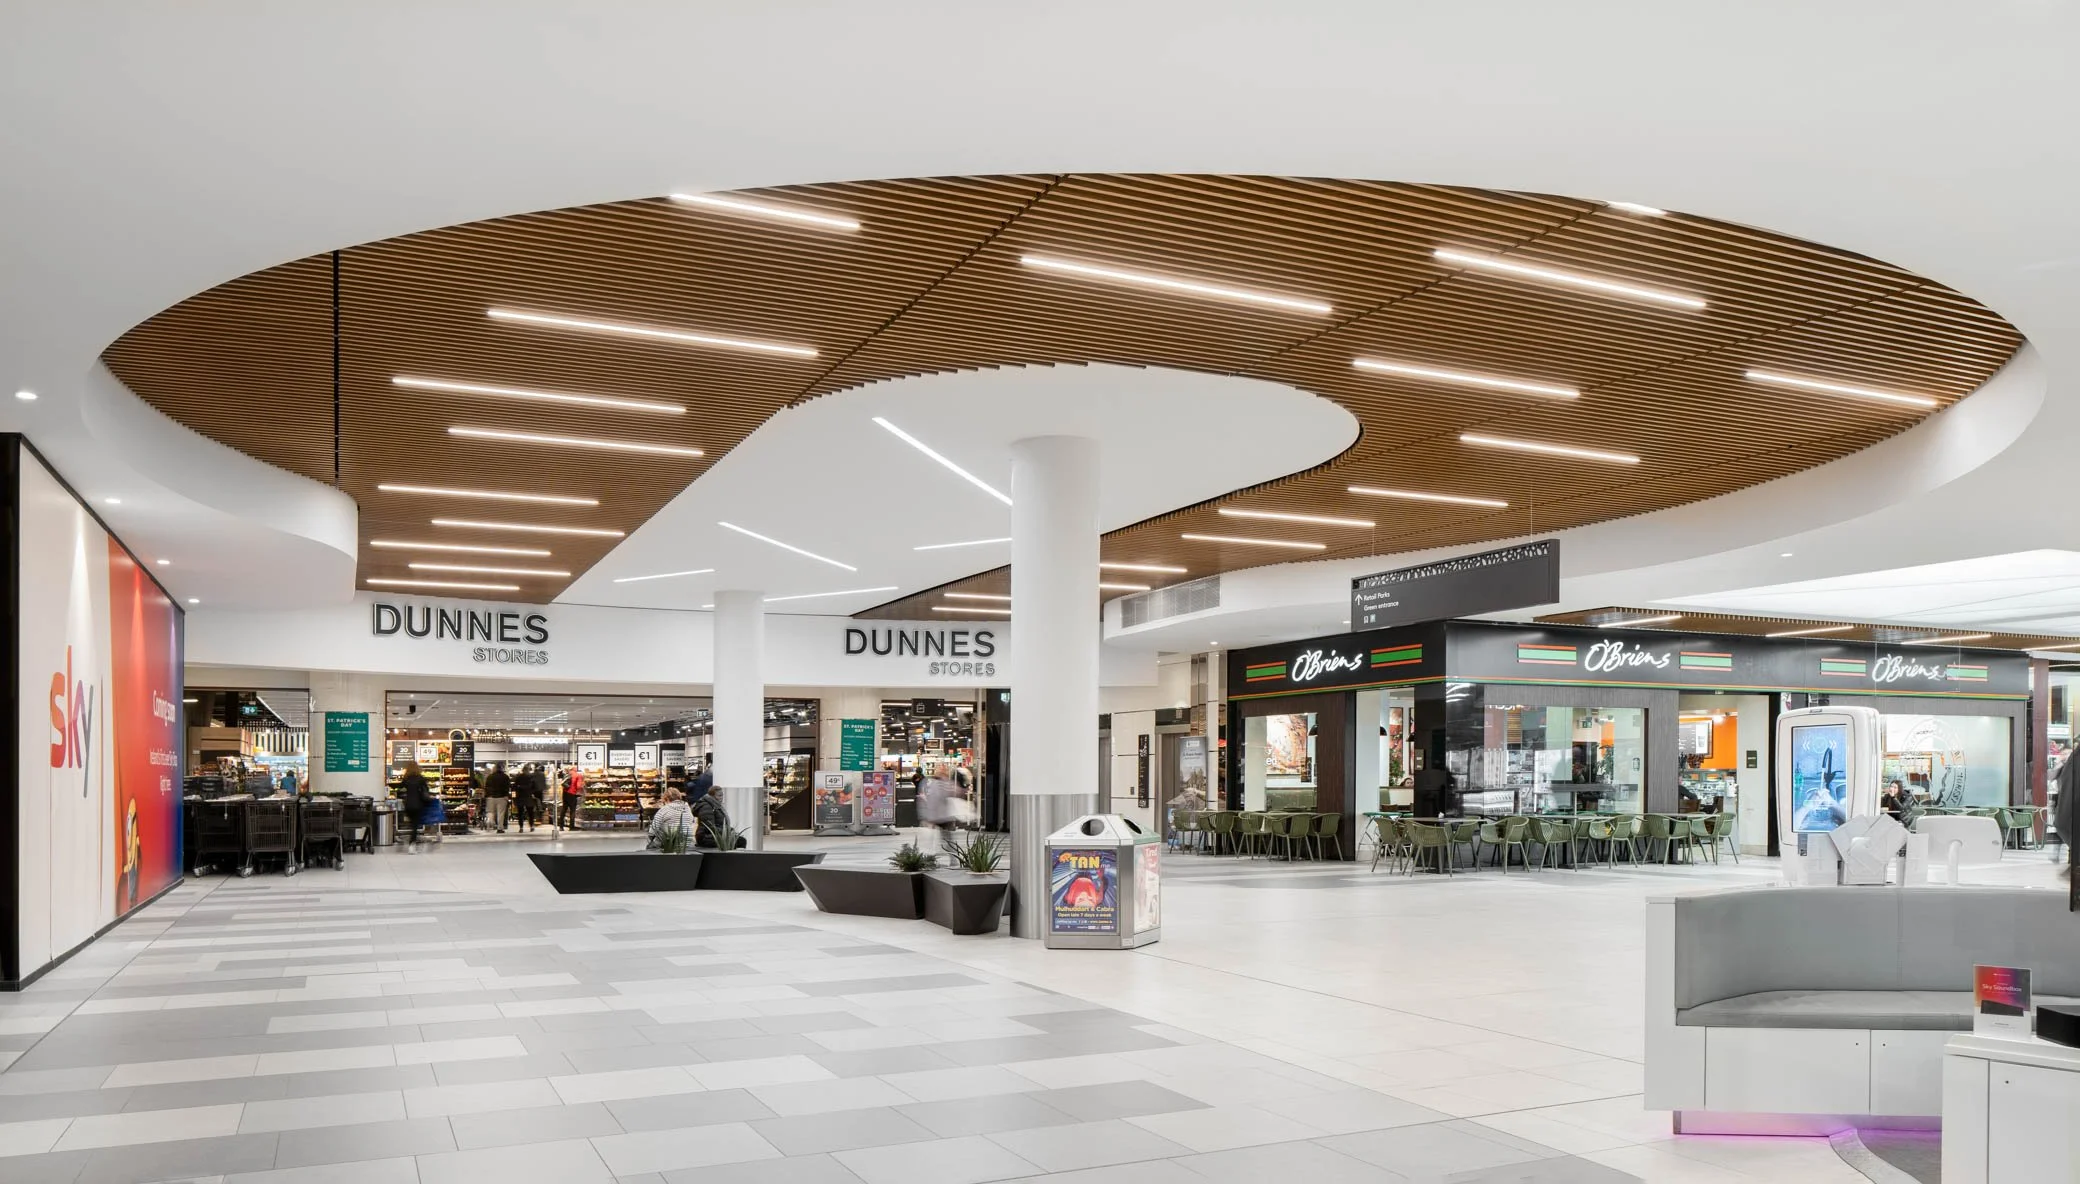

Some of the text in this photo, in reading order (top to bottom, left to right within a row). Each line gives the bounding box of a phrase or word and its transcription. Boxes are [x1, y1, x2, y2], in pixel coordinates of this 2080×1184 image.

[1364, 593, 1376, 601] Retail
[1378, 601, 1399, 609] entrance
[372, 602, 549, 645] DUNNES
[844, 628, 995, 658] DUNNES
[472, 647, 549, 664] STORES
[1585, 639, 1671, 672] O'Briens
[929, 661, 995, 676] STORES
[1292, 650, 1363, 681] O'Briens
[1872, 654, 1940, 682] O'Briens
[50, 645, 93, 798] sky
[585, 751, 597, 760] €1
[638, 751, 650, 760] €1
[1069, 856, 1100, 869] TAN
